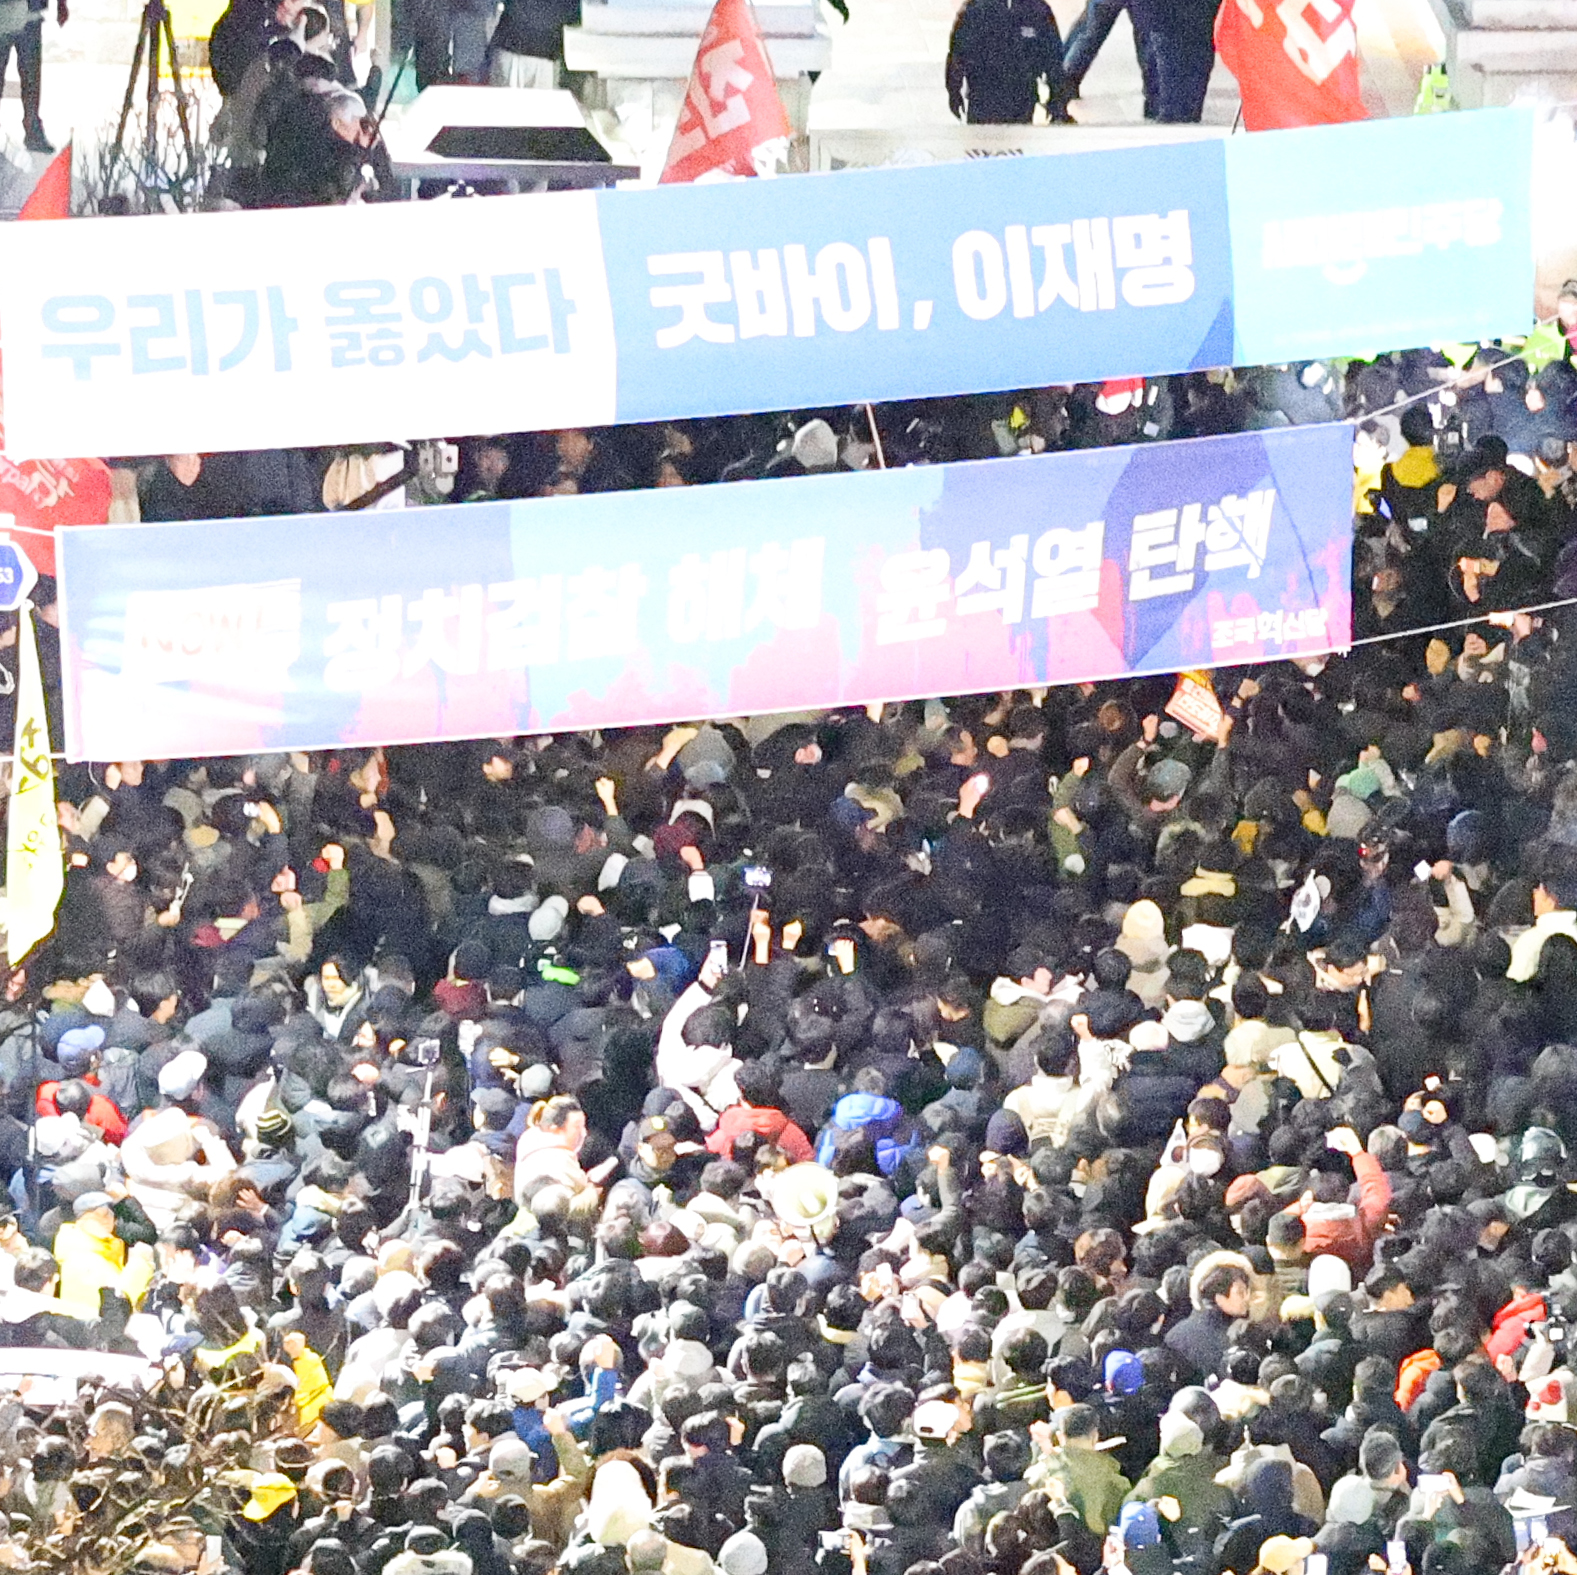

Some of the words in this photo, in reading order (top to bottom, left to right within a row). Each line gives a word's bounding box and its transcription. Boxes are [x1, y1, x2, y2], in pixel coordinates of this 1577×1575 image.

[40, 286, 299, 381] 우리가
[324, 267, 577, 368] 옳았다
[646, 236, 934, 349] 굿바이,
[951, 210, 1196, 321] 이재명
[322, 562, 648, 692] 정치검찰
[666, 536, 826, 644] 해체
[875, 520, 1106, 645] 윤석열
[1127, 488, 1277, 602] 탄핵
[1211, 608, 1330, 651] 조국혁신당
